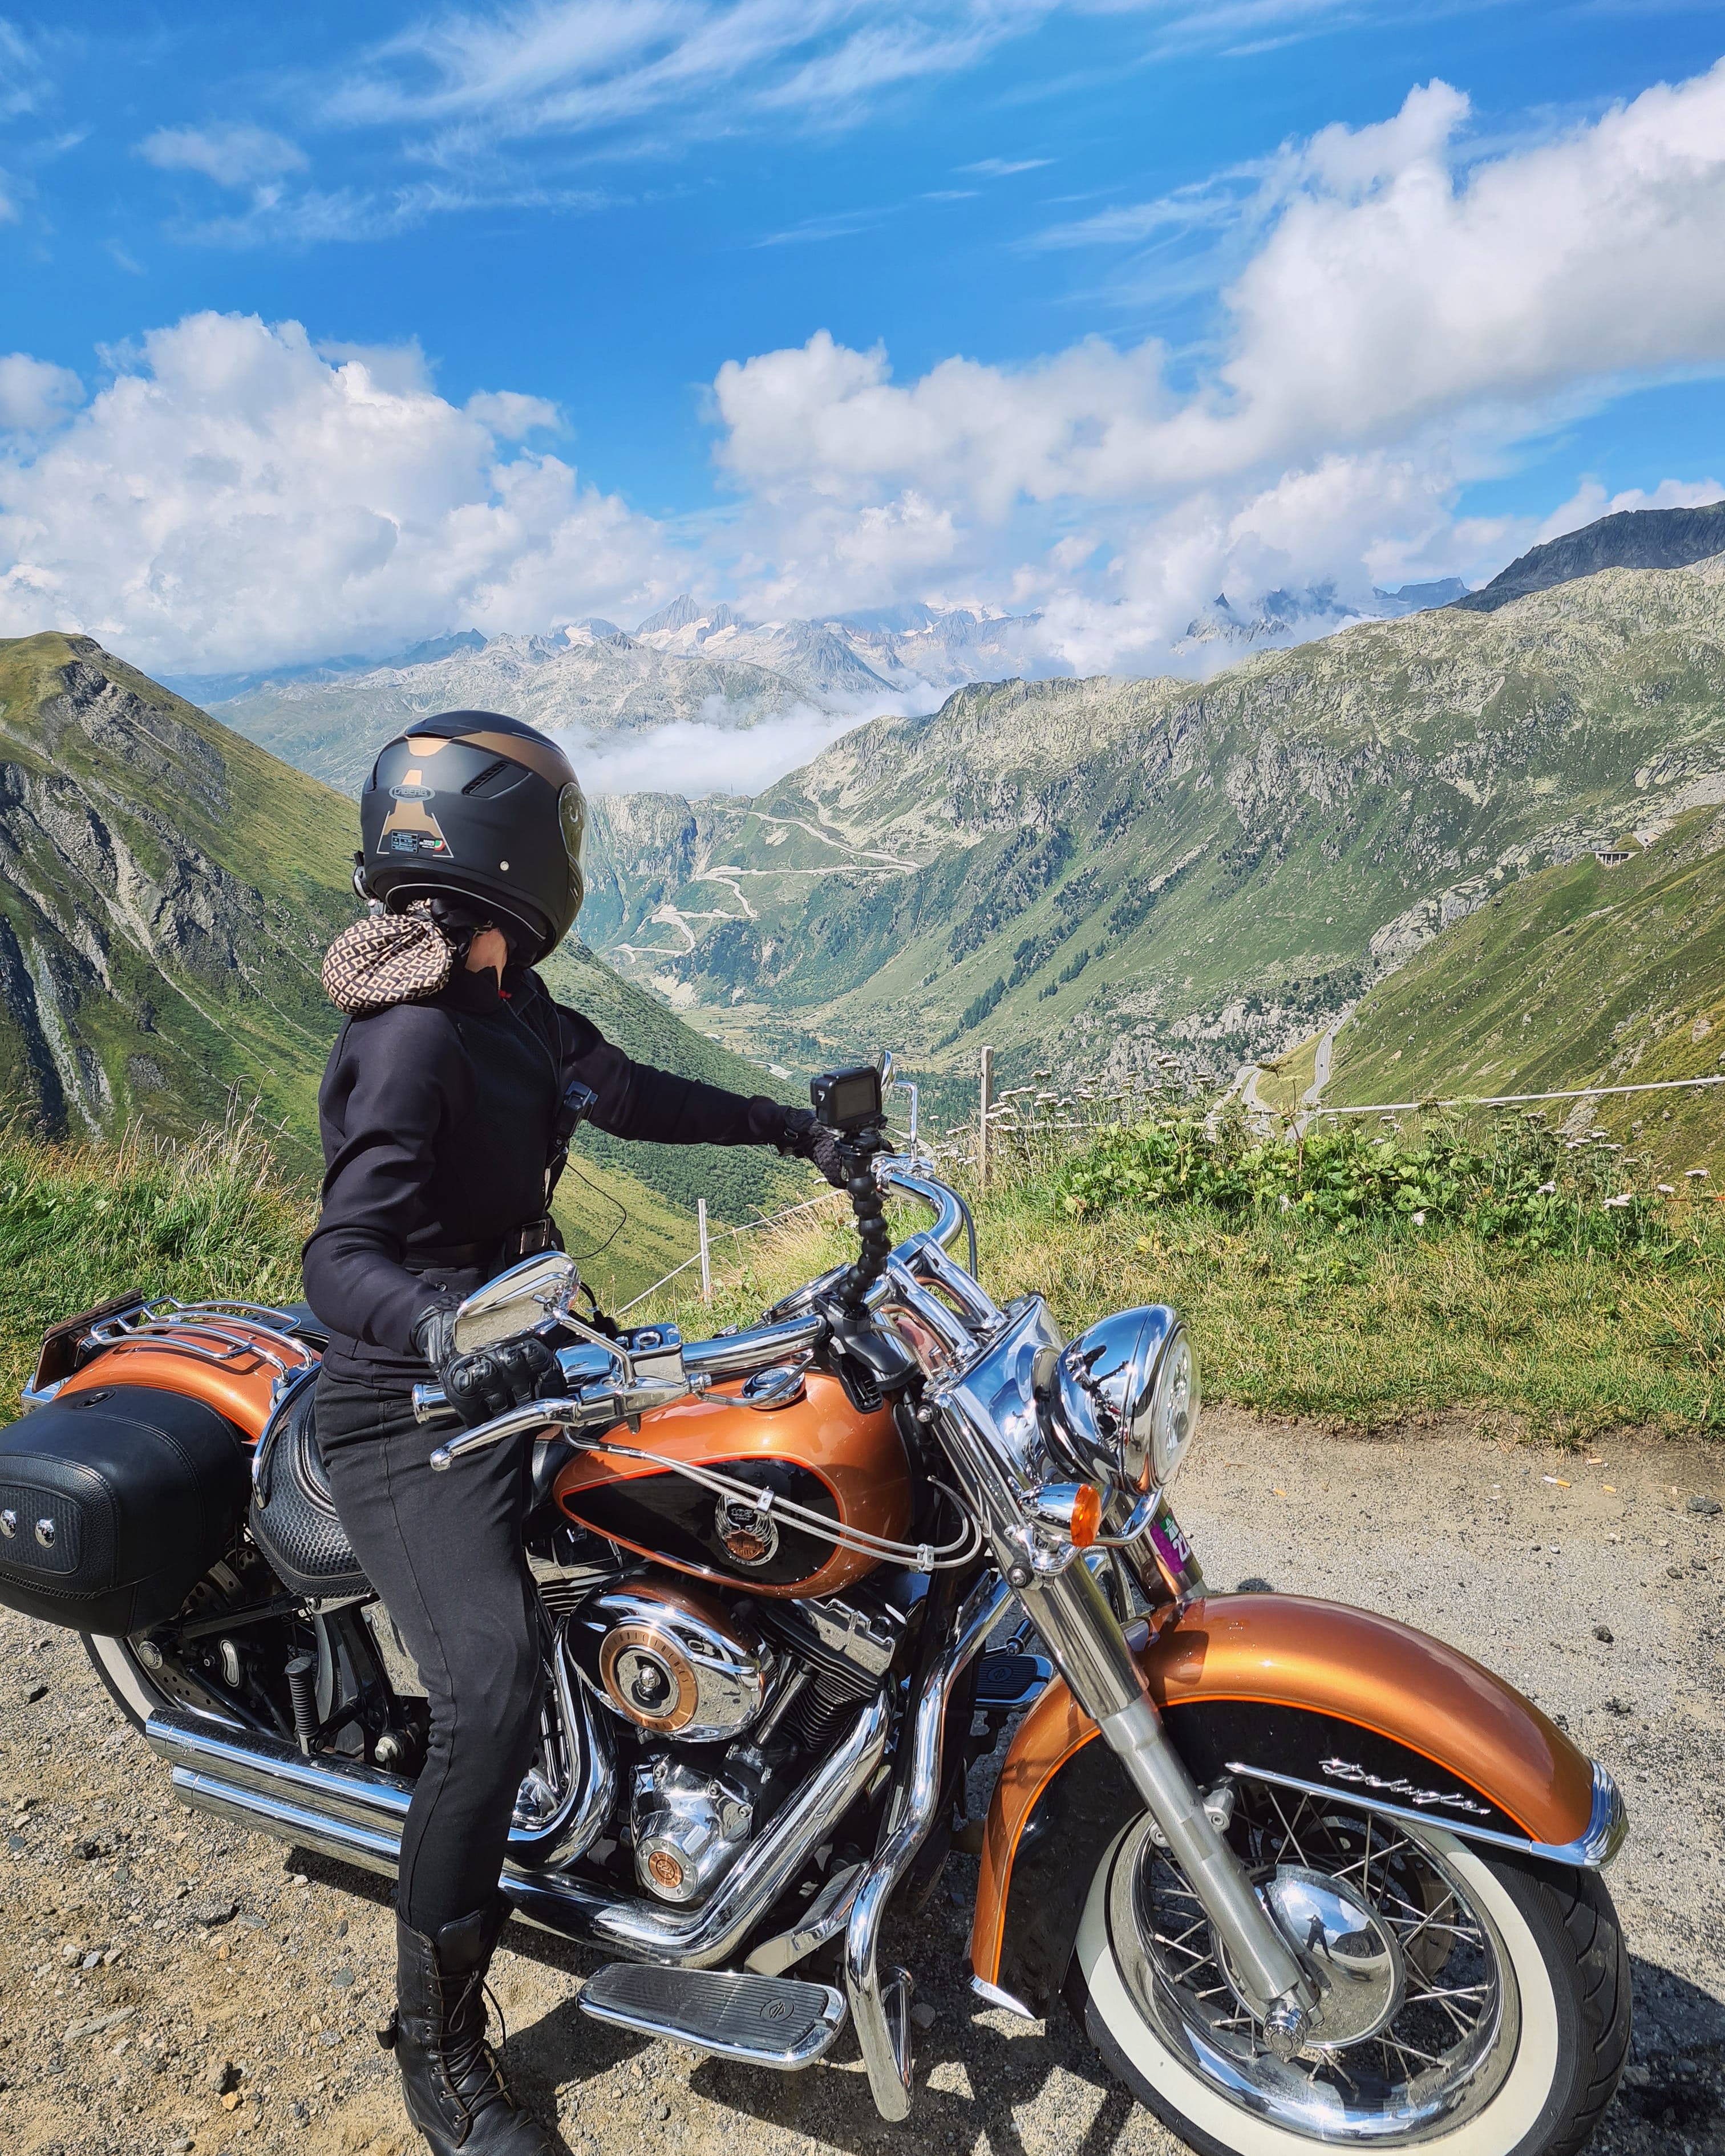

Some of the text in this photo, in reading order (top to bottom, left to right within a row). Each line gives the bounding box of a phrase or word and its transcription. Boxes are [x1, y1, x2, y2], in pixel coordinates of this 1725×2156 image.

[818, 1092, 825, 1102] 7
[731, 1508, 753, 1518] 105
[1172, 1532, 1191, 1562] 22
